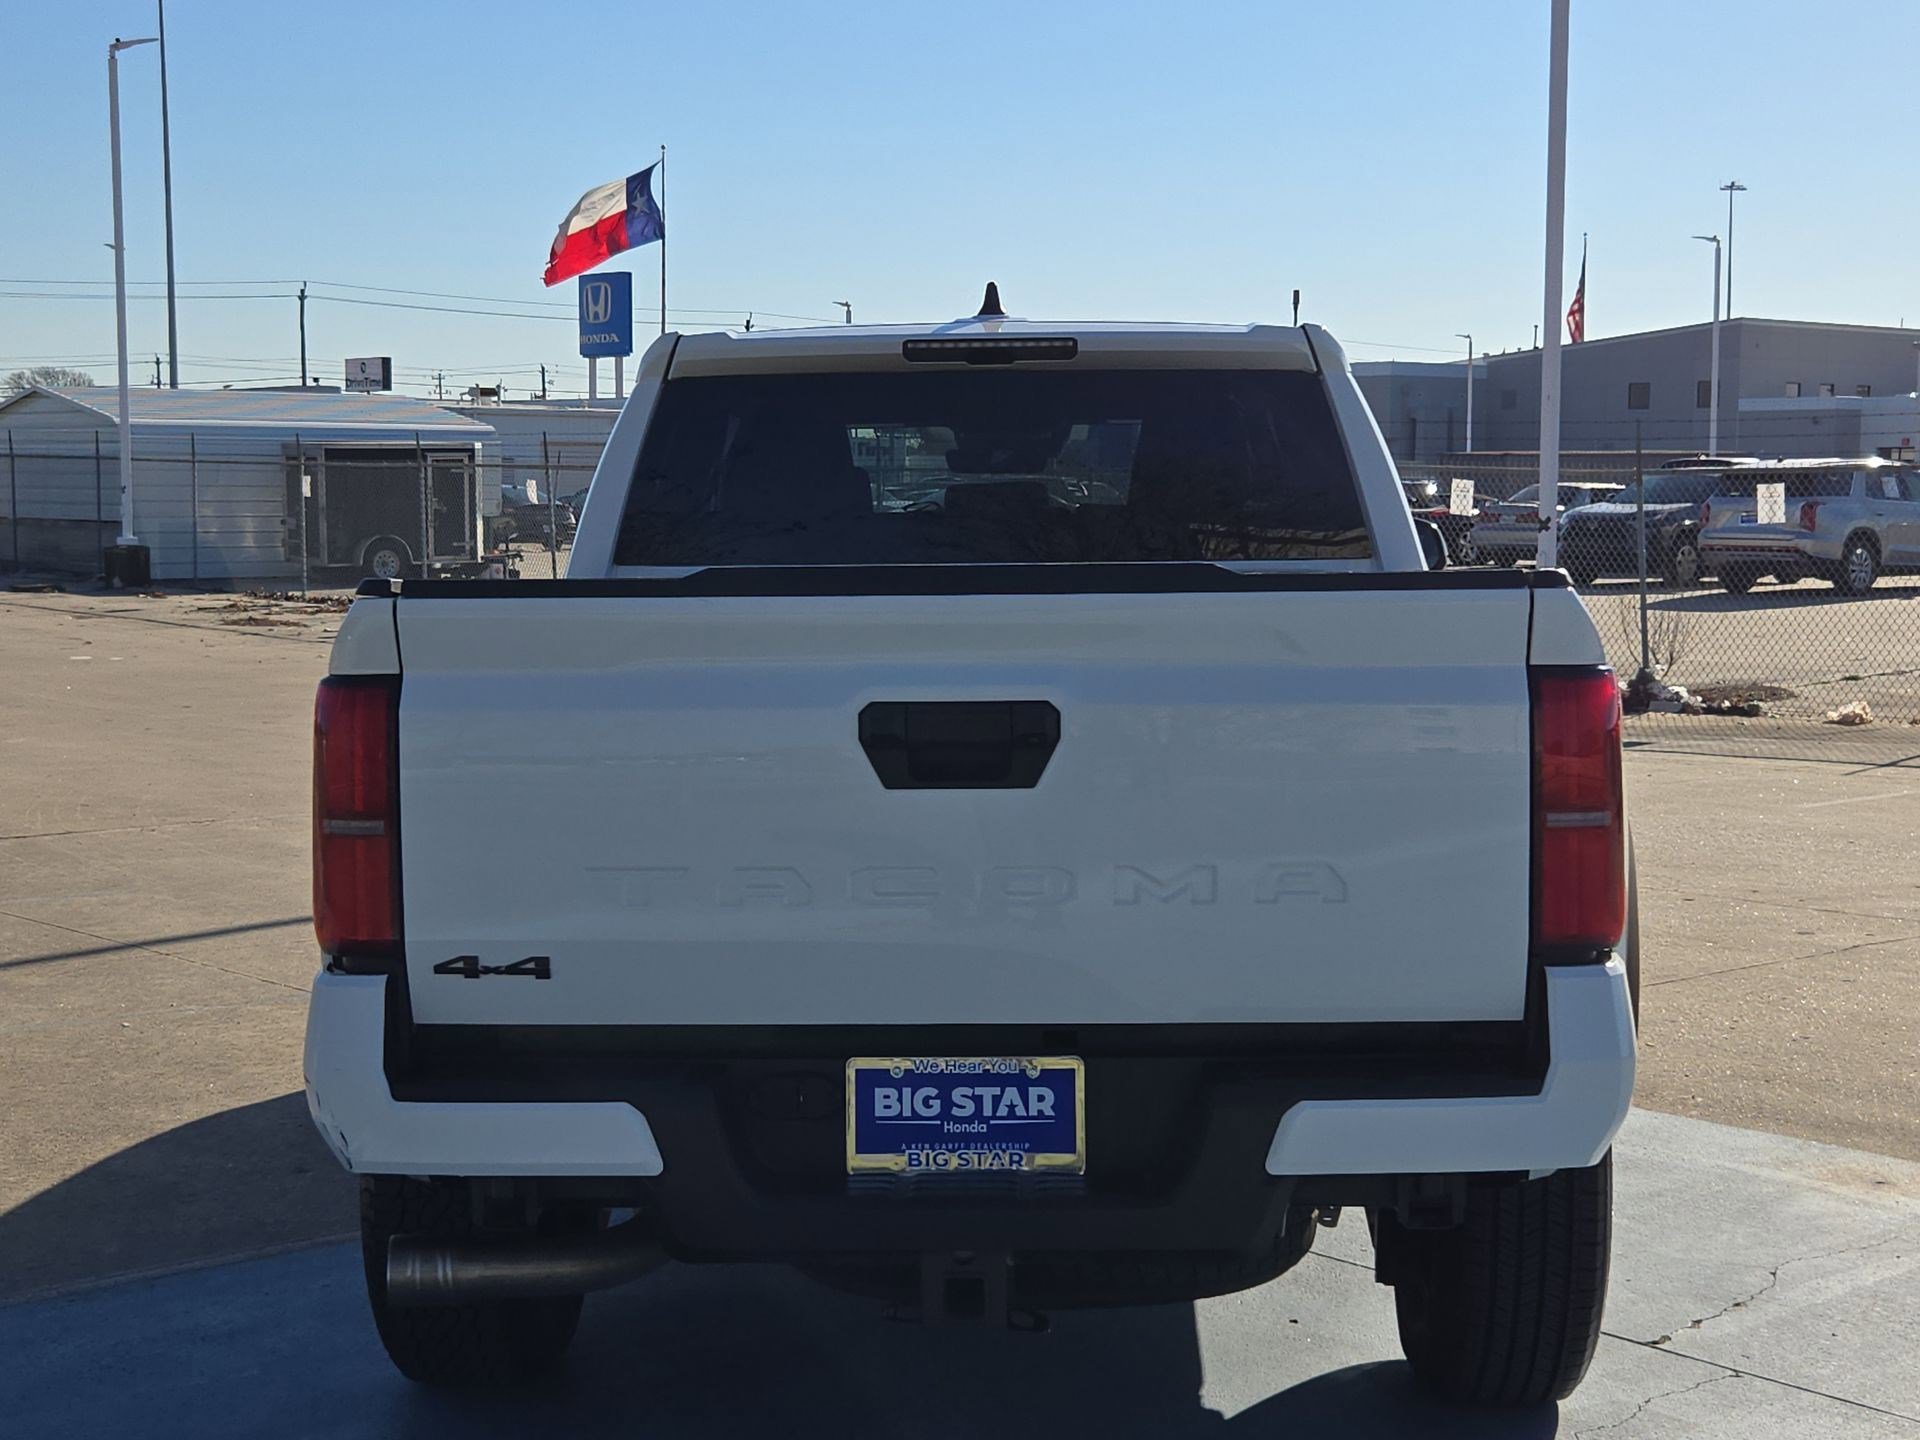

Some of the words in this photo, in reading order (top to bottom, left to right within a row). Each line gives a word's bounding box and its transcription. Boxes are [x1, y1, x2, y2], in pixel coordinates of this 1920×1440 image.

[580, 333, 620, 344] HONDA
[584, 864, 1350, 909] TACOMA
[433, 955, 551, 980] 4x4
[913, 1058, 939, 1073] We
[944, 1059, 983, 1073] Hear
[988, 1059, 1020, 1073] You
[874, 1087, 941, 1117] BIG
[951, 1086, 1055, 1117] STAR
[944, 1121, 987, 1133] Honda
[970, 1142, 1030, 1150] DEALERSHIP
[908, 1151, 949, 1168] BIG
[957, 1151, 1024, 1168] STAR
